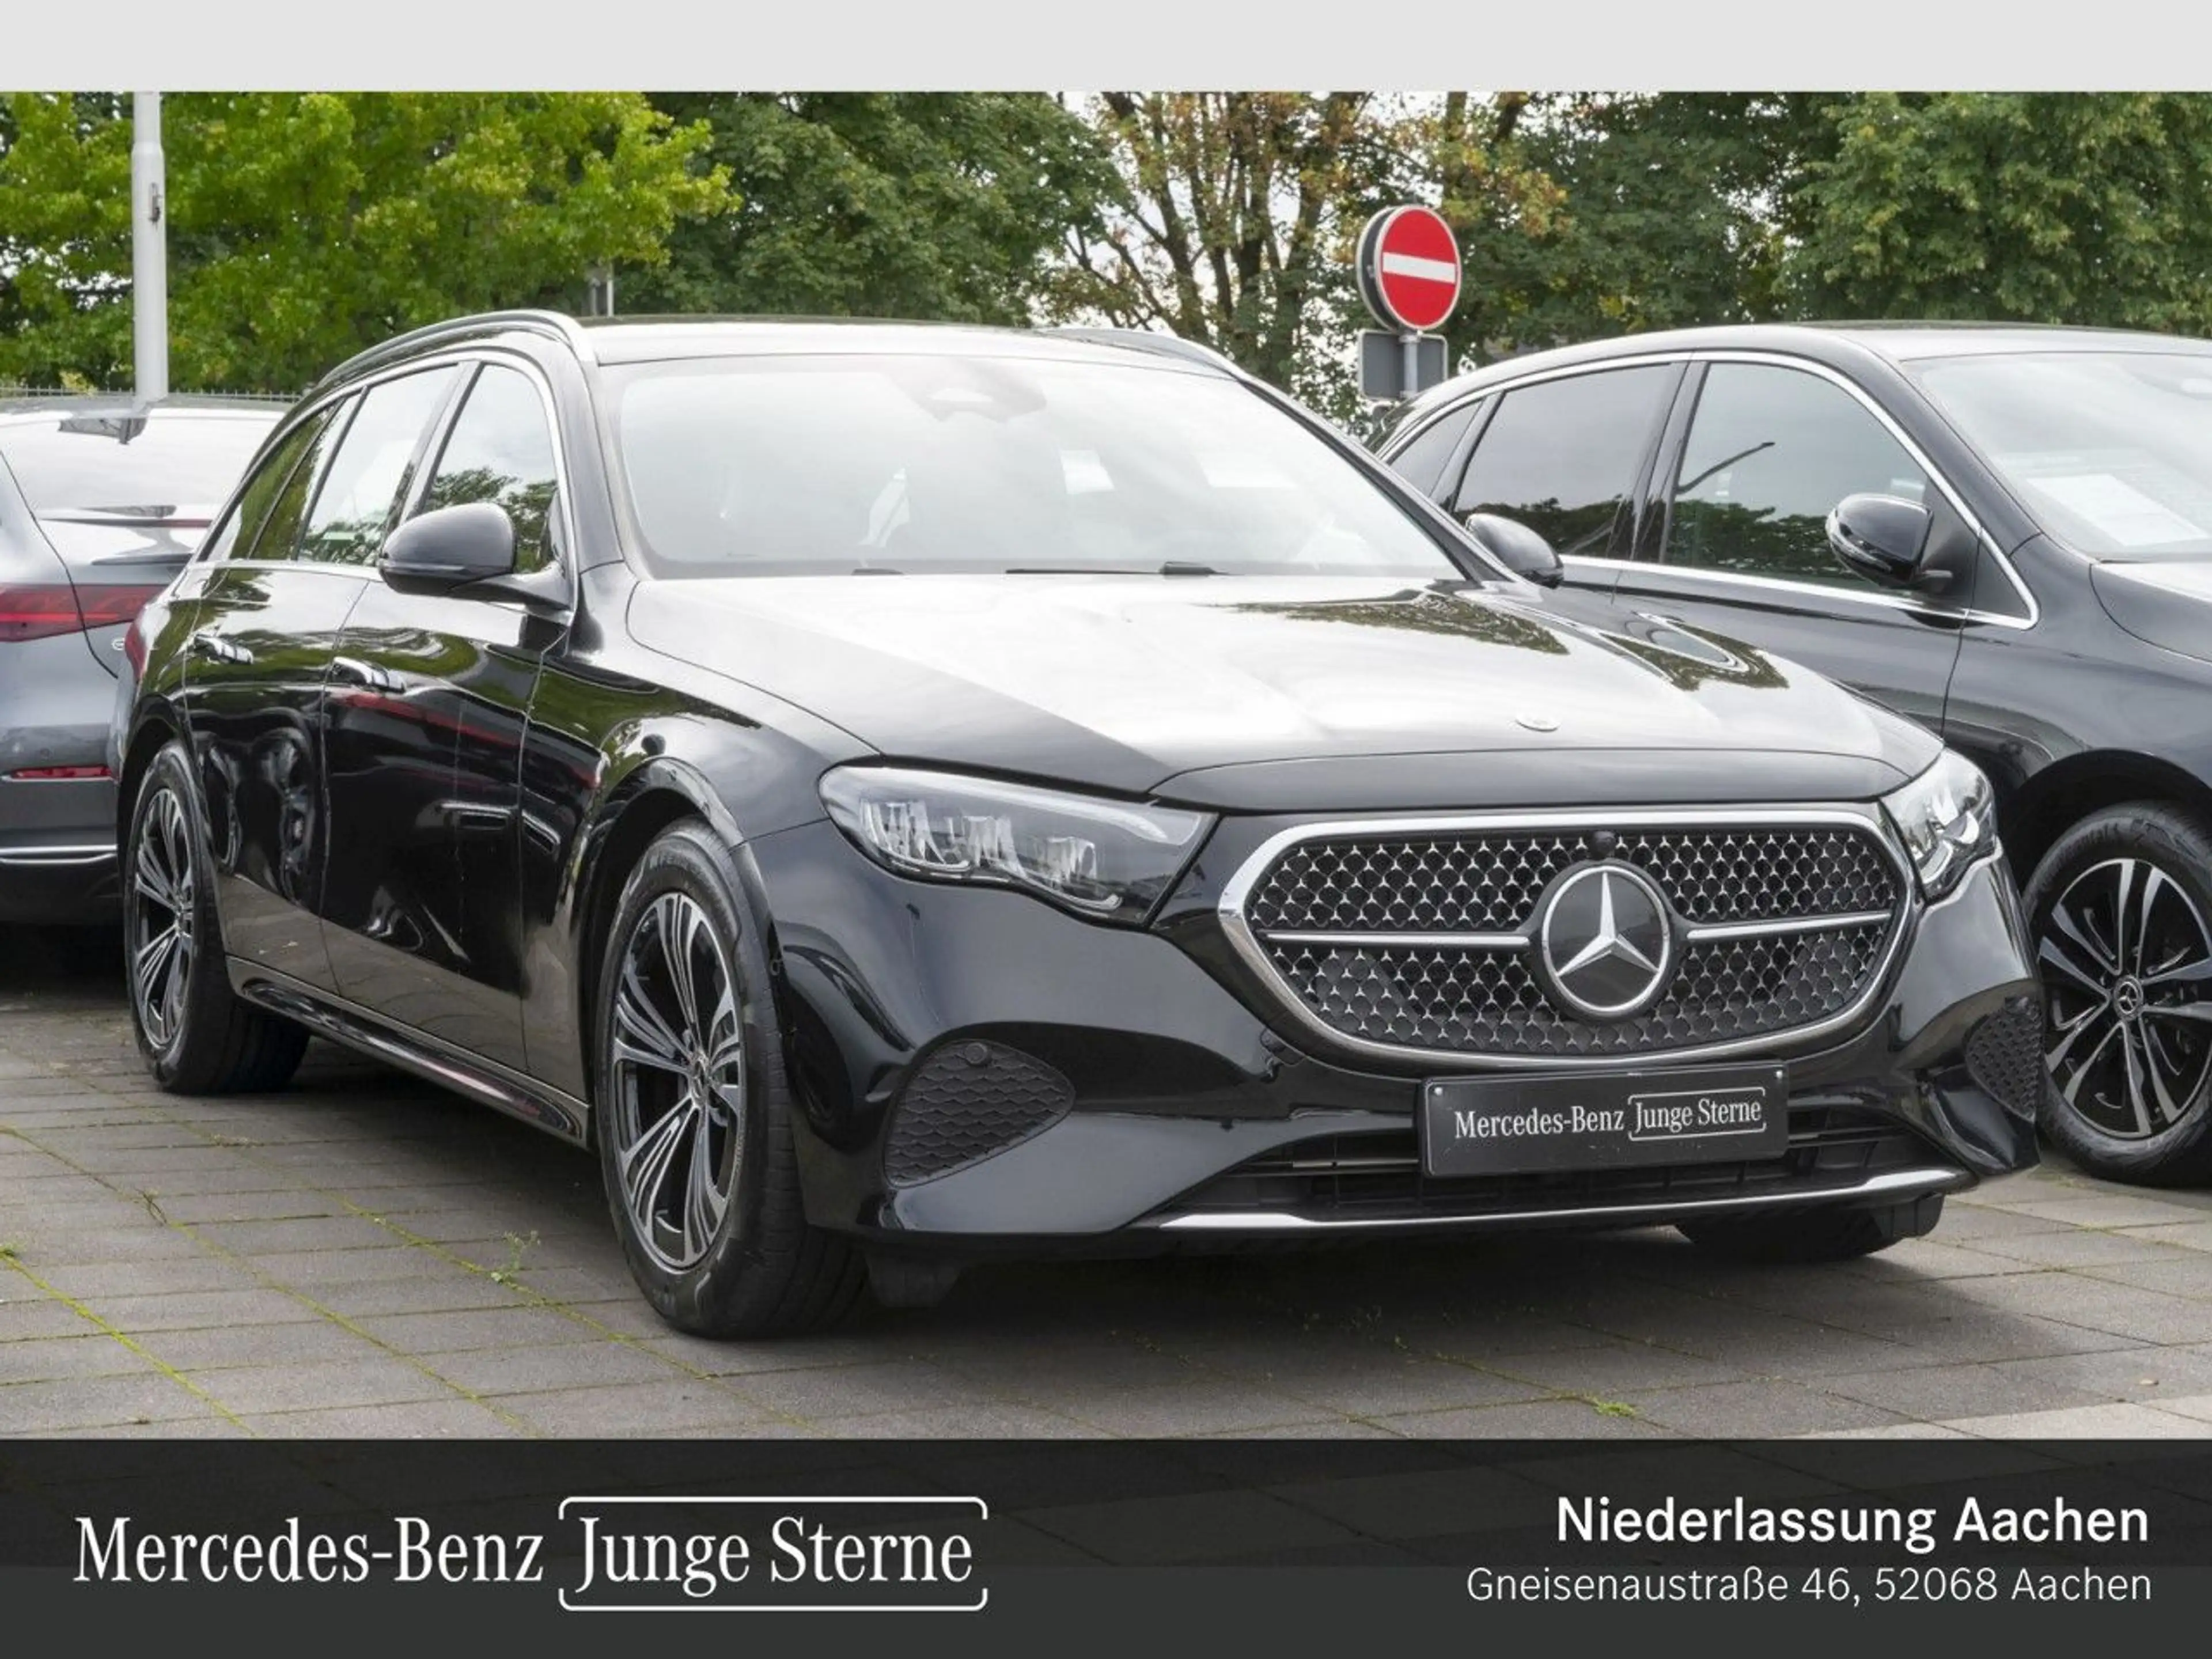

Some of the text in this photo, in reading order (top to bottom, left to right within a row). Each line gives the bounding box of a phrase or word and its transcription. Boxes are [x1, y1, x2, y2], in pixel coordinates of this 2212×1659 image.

[1454, 1098, 1762, 1139] Mercedes-Benz Junge Sterne
